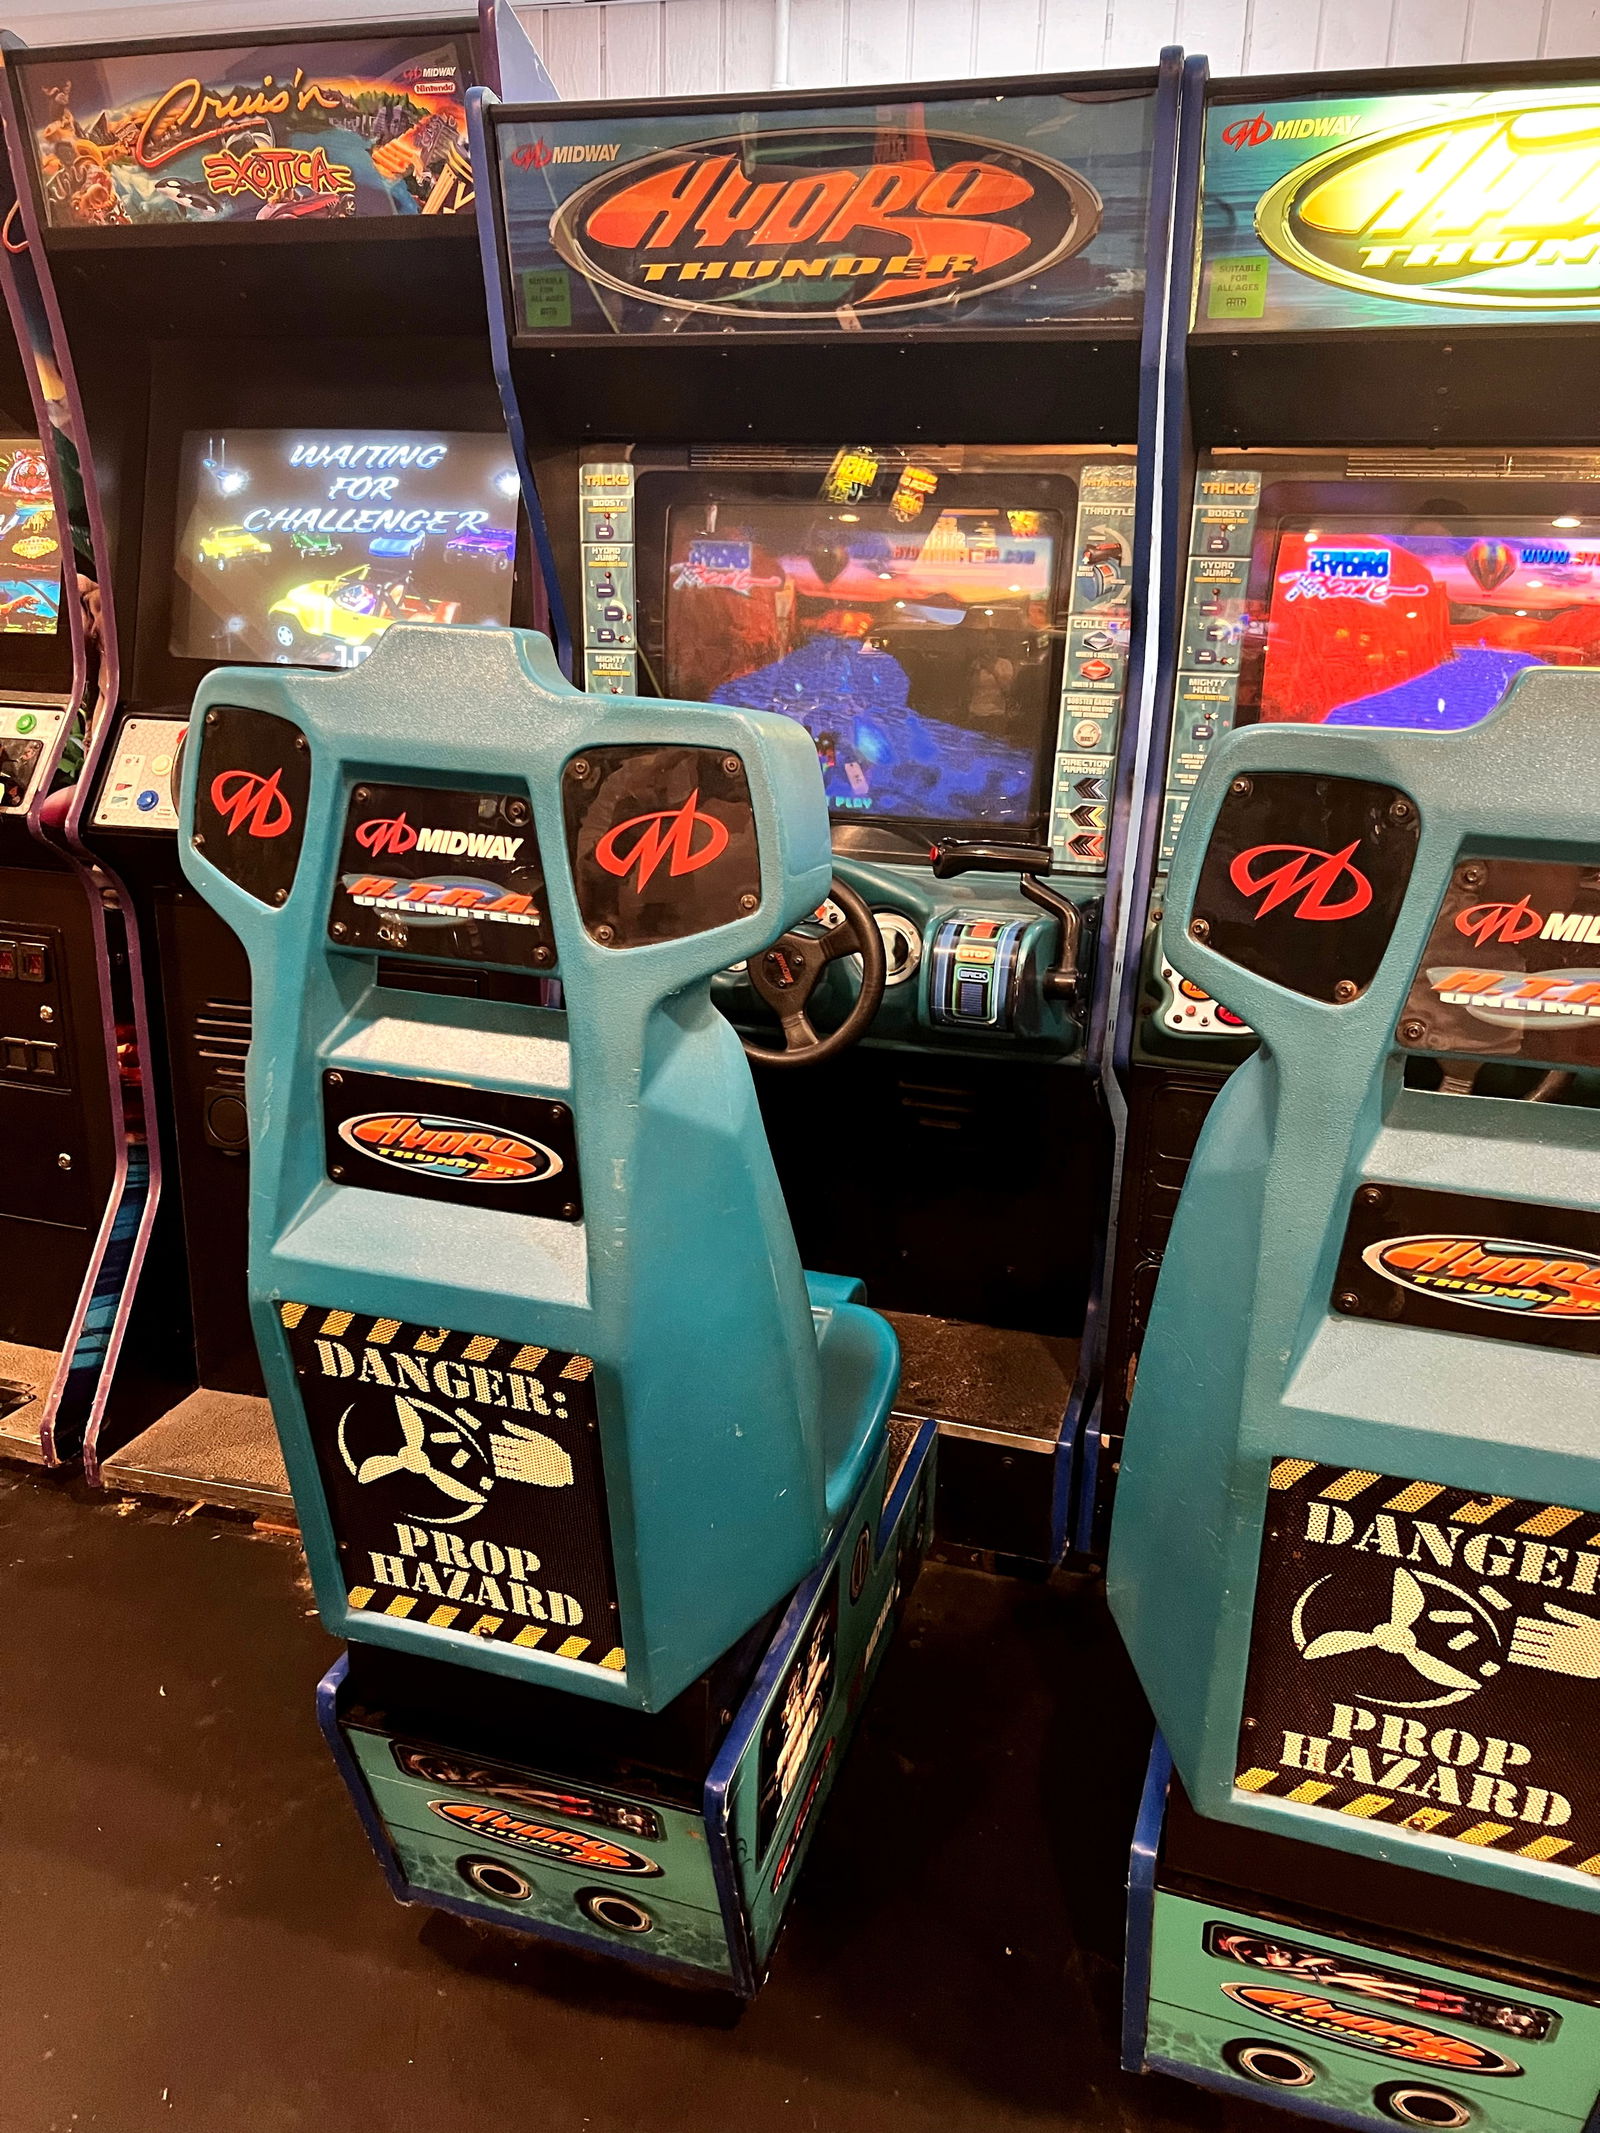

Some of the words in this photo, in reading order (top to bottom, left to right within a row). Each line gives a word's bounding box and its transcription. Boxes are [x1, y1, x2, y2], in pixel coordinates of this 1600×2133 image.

[423, 67, 456, 77] MIDWAY
[416, 84, 453, 92] Nintendo
[135, 66, 341, 168] Cruis'n
[1272, 115, 1361, 140] MIDWAY
[552, 143, 621, 165] MIDWAY
[205, 147, 355, 199] EXOTICA
[586, 154, 1034, 272] HYDRO
[641, 253, 977, 283] THUNDER
[1219, 264, 1261, 273] SUITABLE
[1217, 284, 1232, 292] ALL
[1235, 283, 1259, 291] AGES
[289, 444, 448, 469] WAITING
[328, 476, 400, 501] FOR
[585, 474, 630, 487] TRICKS
[1201, 482, 1257, 495] TRICKS
[242, 508, 490, 533] CHALLENGER
[1208, 509, 1244, 518] BOOST:
[592, 547, 621, 555] HYDRO
[1200, 561, 1235, 569] HYDRO
[1202, 569, 1234, 577] JUMP:
[595, 655, 627, 664] MIGHTY
[1188, 678, 1228, 688] MIGHTY
[1060, 760, 1110, 768] DIRECTION
[415, 828, 525, 861] MIDWAY
[346, 876, 541, 916] H.T.R.A.
[352, 895, 531, 925] UNLIMITED
[961, 948, 990, 959] STOP
[960, 970, 988, 980] BACK
[351, 1117, 538, 1171] HYDRO
[376, 1147, 517, 1175] THUNDER
[313, 1339, 569, 1420] DANGER:
[393, 1522, 542, 1582] PROP
[367, 1551, 585, 1627] HAZARD
[1328, 1702, 1532, 1776] PROP
[1278, 1729, 1573, 1827] HAZARD
